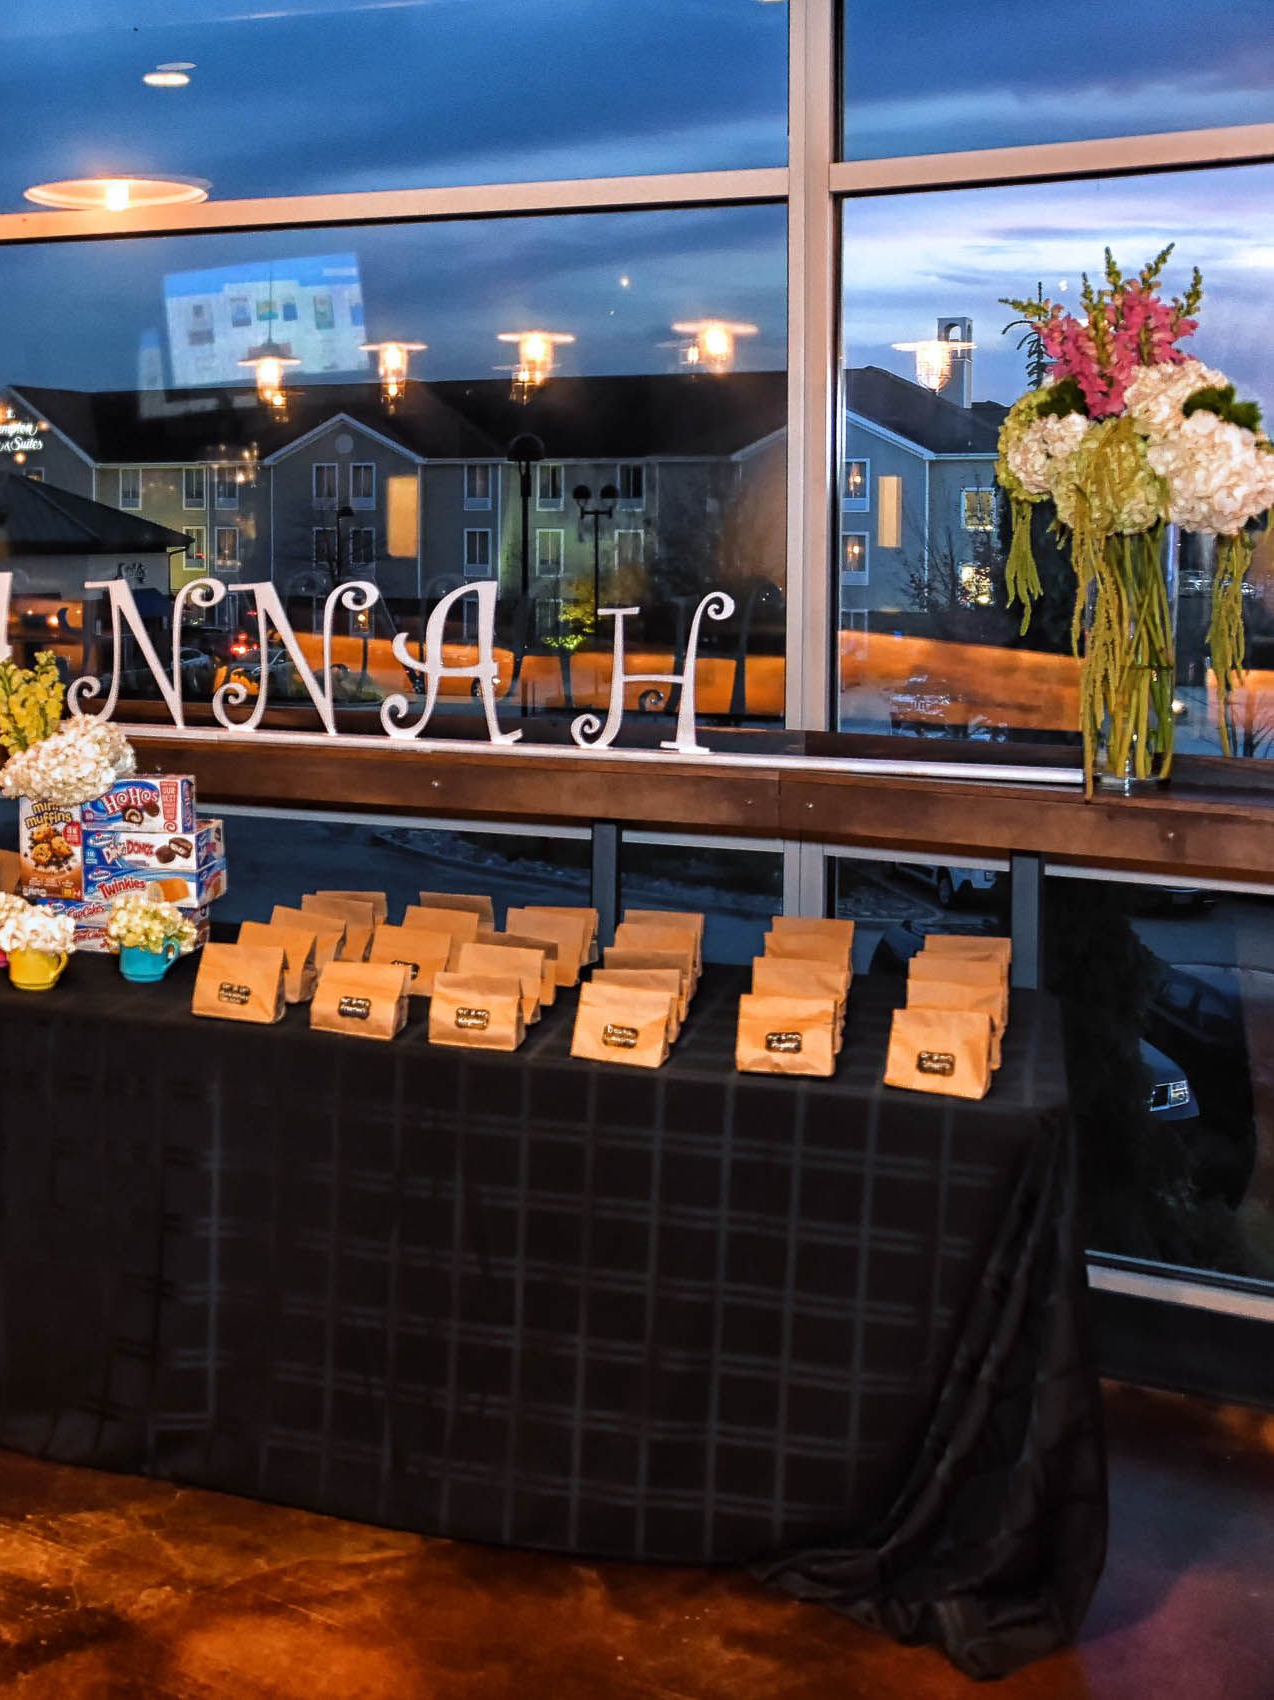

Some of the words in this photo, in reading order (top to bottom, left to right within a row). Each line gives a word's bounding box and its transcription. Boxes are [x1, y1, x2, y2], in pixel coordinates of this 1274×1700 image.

[10, 437, 44, 451] Suites
[24, 811, 72, 829] muffins
[97, 877, 146, 899] Twinkies
